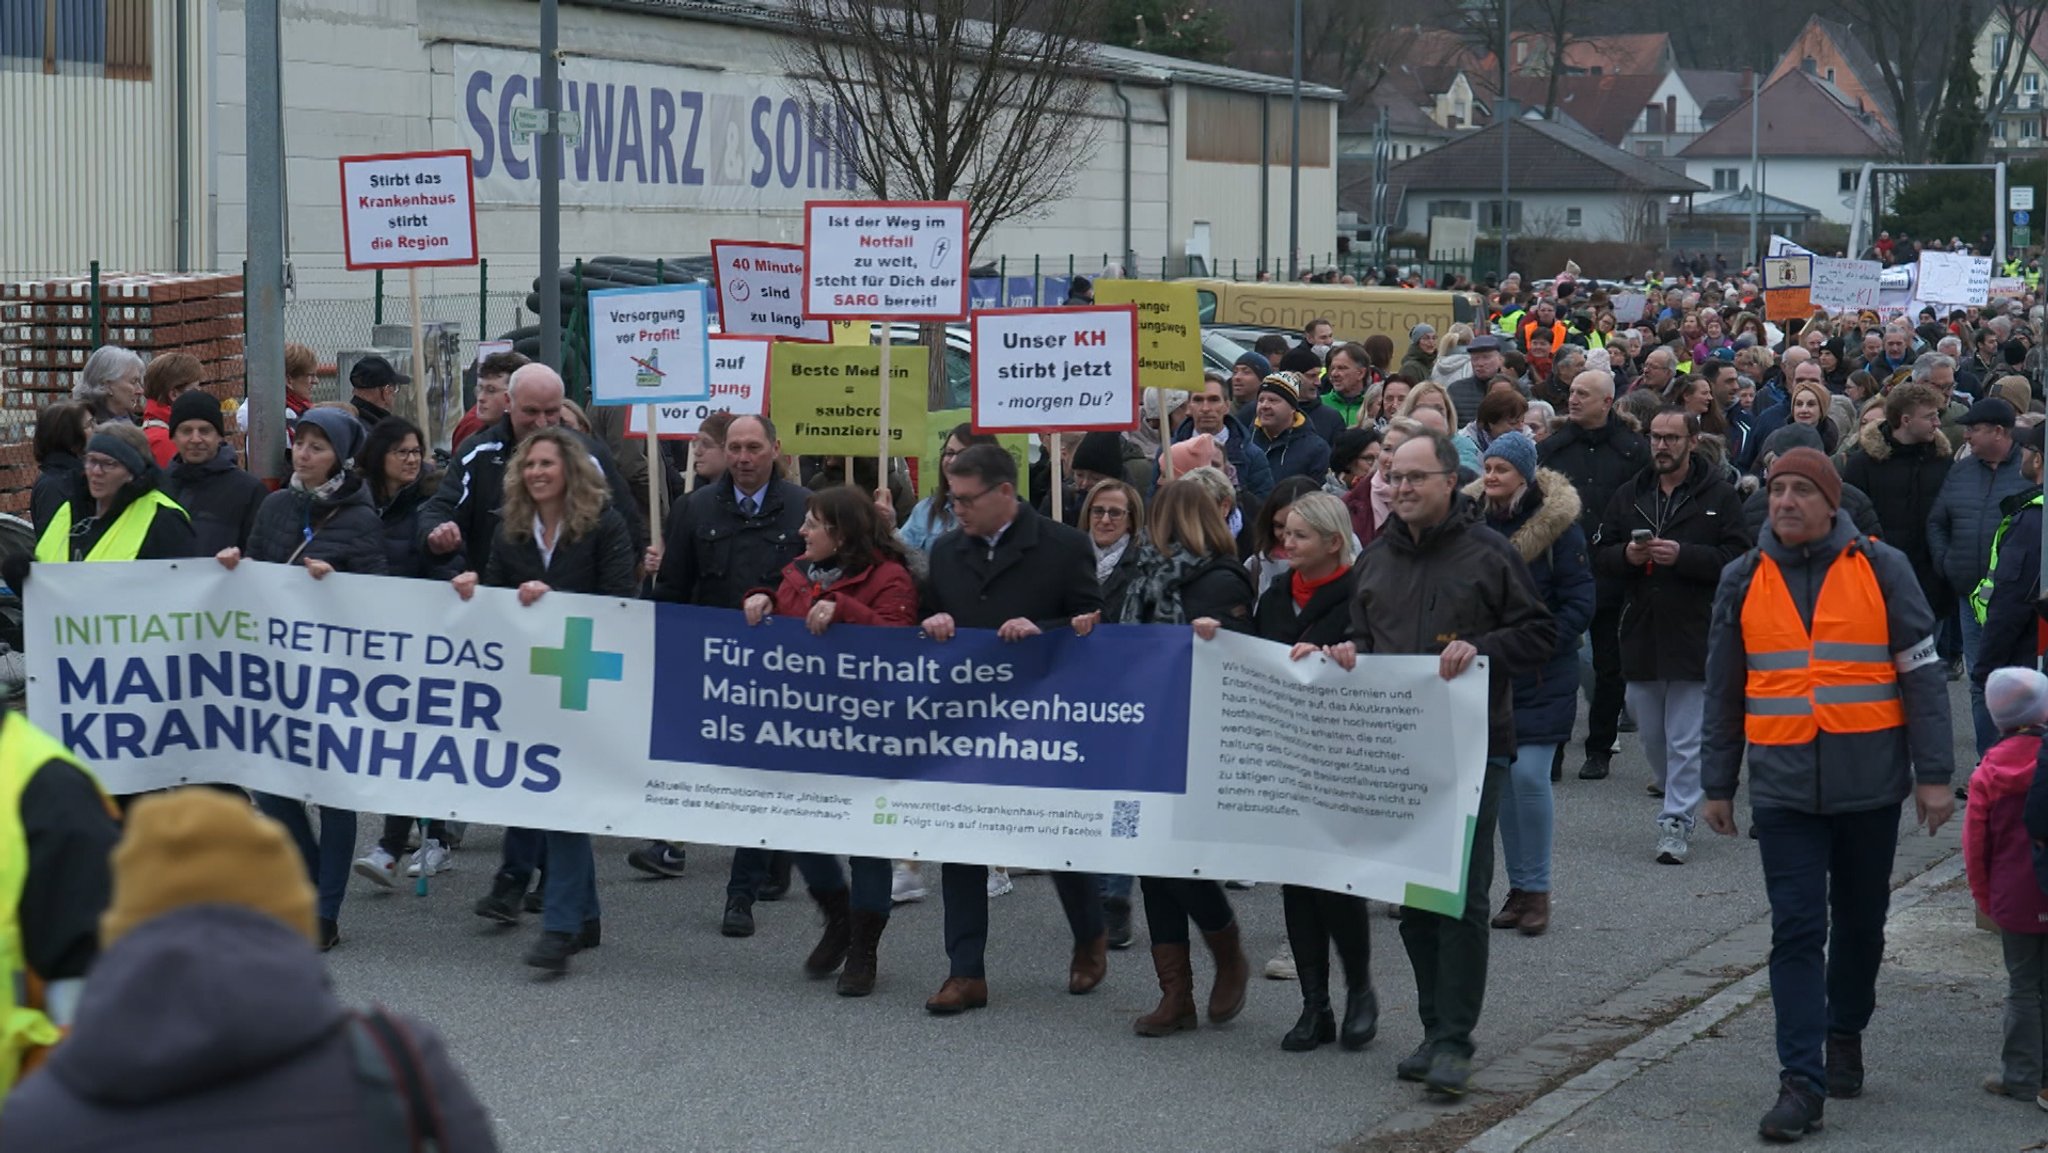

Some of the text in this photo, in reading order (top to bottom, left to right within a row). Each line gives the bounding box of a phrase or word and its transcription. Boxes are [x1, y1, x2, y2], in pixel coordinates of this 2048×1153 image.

[724, 121, 744, 183] &
[370, 173, 441, 188] Stirbt das
[359, 193, 456, 209] Krankenhaus
[388, 216, 428, 228] stirbt
[829, 216, 946, 231] Ist der Weg im
[371, 235, 449, 250] die Region
[860, 235, 914, 248] Notfall
[732, 258, 803, 274] 40 Minute
[854, 256, 918, 269] zu weit,
[815, 275, 956, 287] steht für Dich der
[761, 287, 790, 300] sind
[834, 294, 937, 307] SARG bereit!
[610, 308, 686, 325] Versorgung
[751, 312, 766, 323] zu
[1238, 300, 1451, 332] Sonnenstrom
[616, 329, 681, 344] vor Profit!
[1003, 330, 1107, 349] Unser KH
[715, 356, 746, 370] auf
[998, 360, 1112, 382] stirbt jetzt
[791, 364, 909, 379] Beste Medzin
[1008, 392, 1074, 412] morgen
[1079, 391, 1114, 408] Du?
[662, 406, 690, 419] vor
[55, 610, 504, 672] INITIATIVE: RETTET DAS
[703, 637, 1014, 684] Für den Erhalt des
[58, 651, 503, 733] MAINBURGER
[703, 675, 1145, 724] Mainburger Krankenhauses
[1340, 687, 1387, 699] Gremien
[1389, 689, 1413, 699] und
[1222, 692, 1247, 703] haus
[1249, 694, 1257, 704] in
[1310, 715, 1341, 725] seiner
[1343, 716, 1418, 733] hochwertigen
[1308, 700, 1327, 710] auf,
[1328, 701, 1347, 712] das
[1349, 703, 1425, 716] Akutkranken-
[700, 715, 1086, 763] als Akutkrankenhaus.
[1220, 725, 1272, 738] wendigen
[1328, 747, 1343, 755] zur
[1346, 747, 1406, 760] Aufrechter-
[1356, 733, 1373, 743] die
[61, 705, 562, 793] KRANKENHAUS
[1219, 753, 1235, 764] für
[1238, 756, 1263, 767] eine
[1220, 739, 1264, 753] haltung
[1388, 766, 1411, 776] und
[645, 779, 692, 793] Aktuelle
[695, 783, 774, 800] Informationen
[777, 791, 795, 801] zur
[1218, 786, 1255, 796] einem
[1257, 789, 1311, 803] regionalen
[1219, 771, 1232, 780] zu
[1235, 770, 1275, 784] tätigen
[1378, 794, 1406, 804] nicht
[1407, 797, 1421, 806] zu
[645, 794, 680, 806] Rettet
[681, 797, 702, 808] das
[705, 799, 769, 815] Mainburger
[1216, 801, 1301, 816] herabzustufen.
[903, 815, 932, 830] Folgt
[935, 819, 955, 829] uns
[958, 819, 977, 830] auf
[978, 821, 1034, 835] Instagram
[1038, 824, 1059, 836] und
